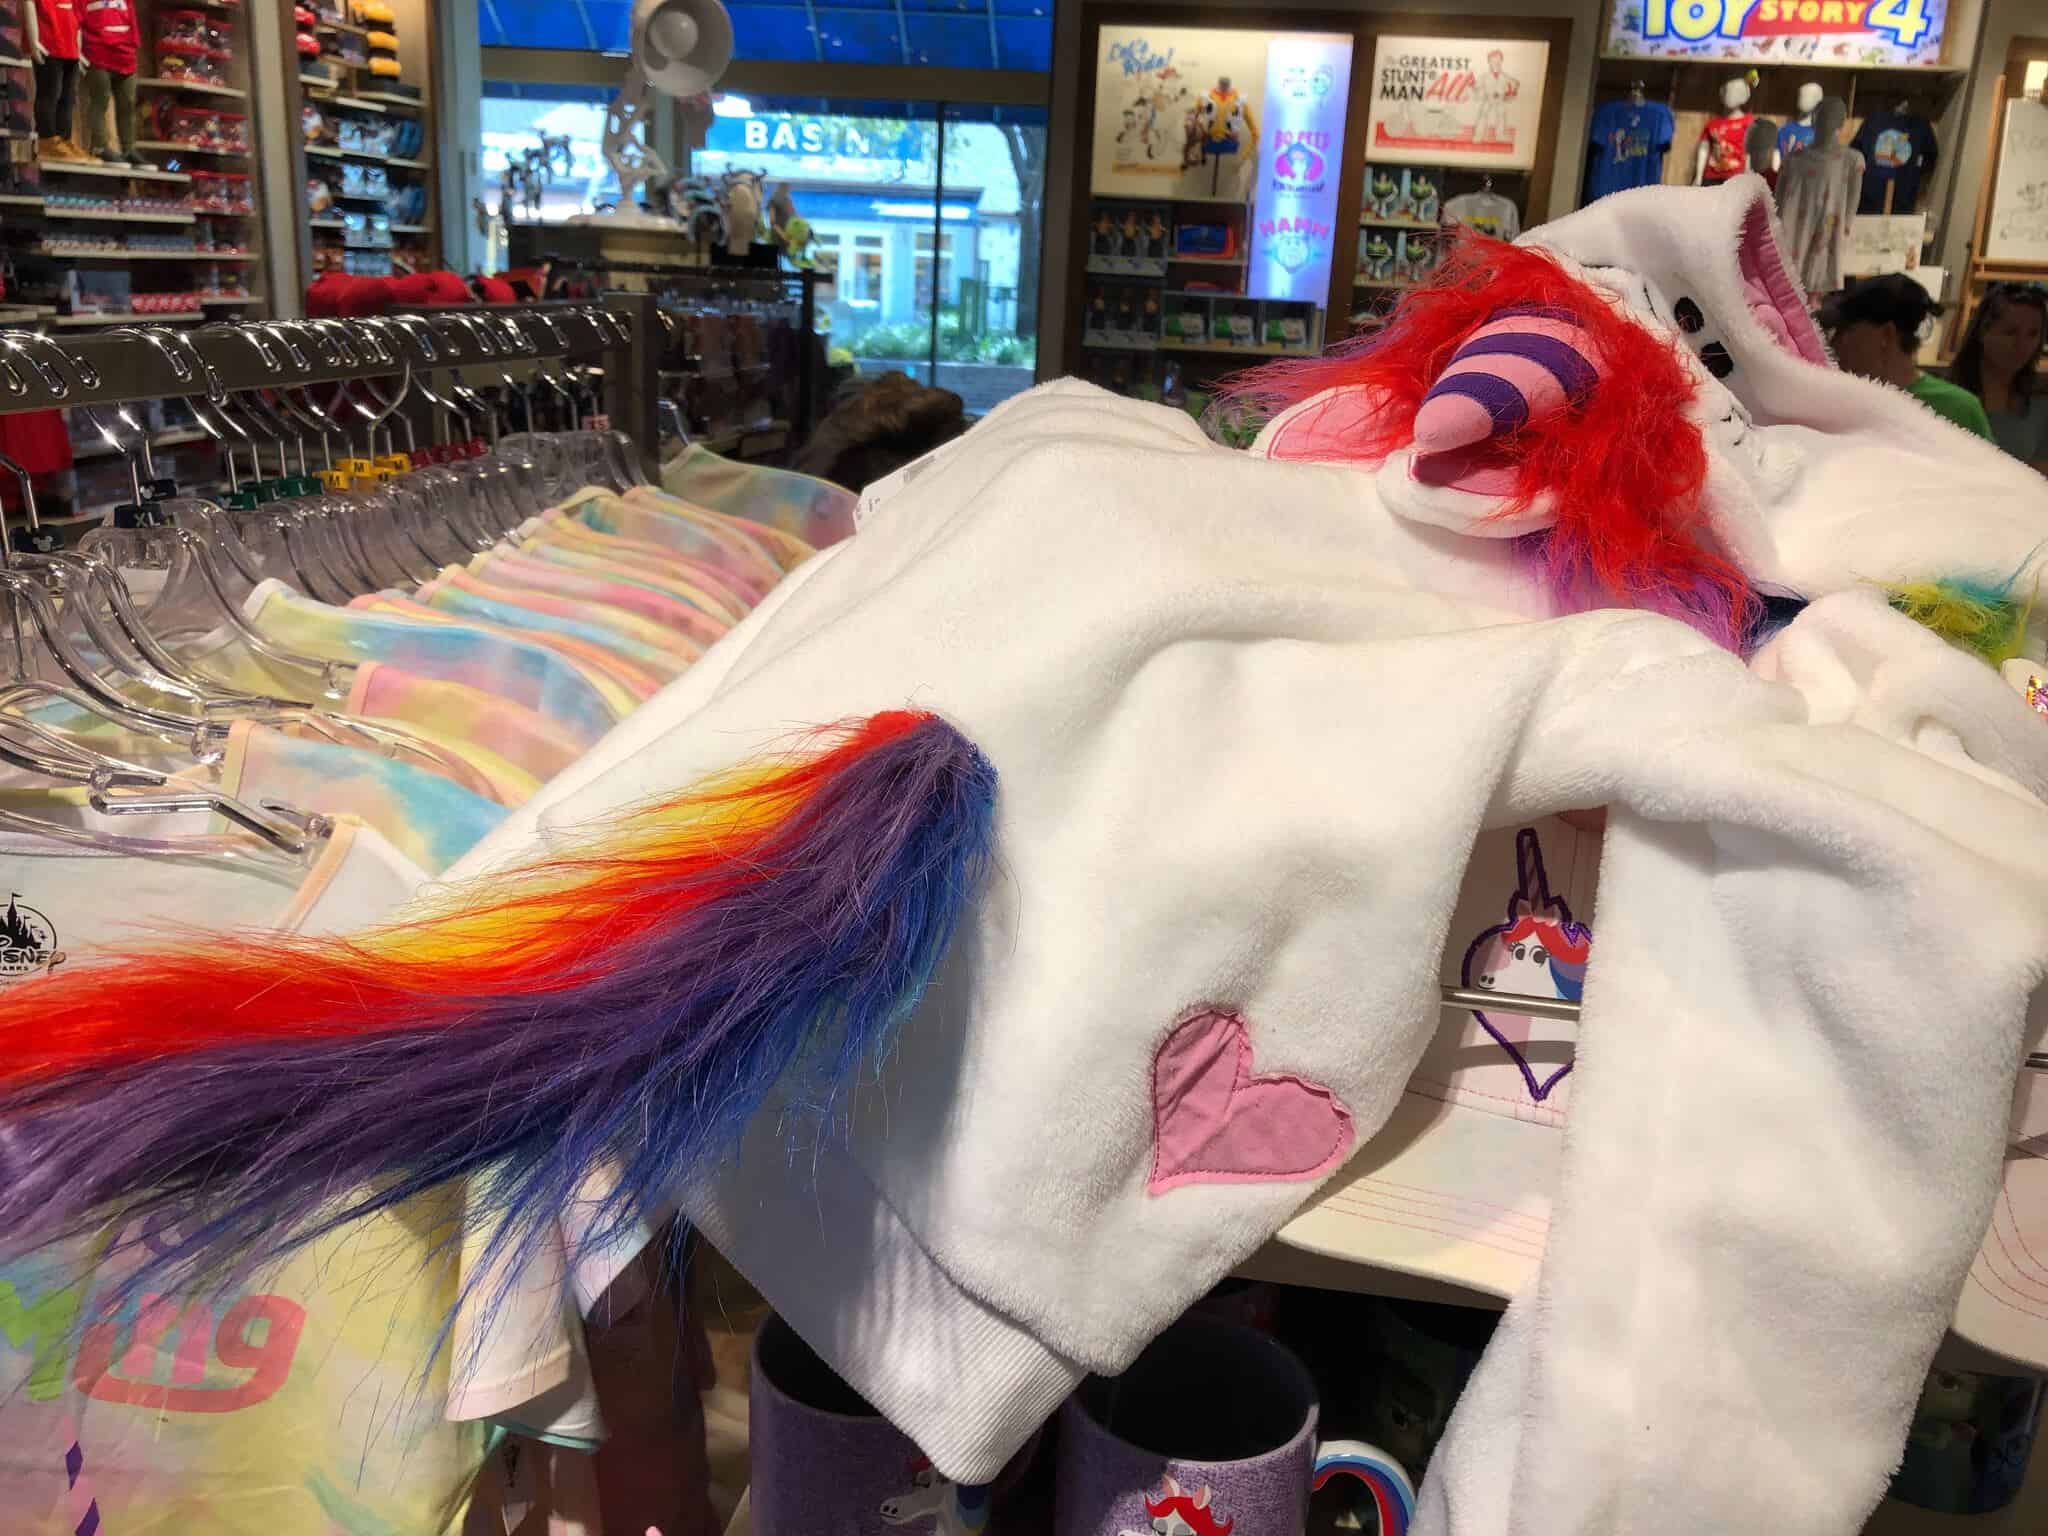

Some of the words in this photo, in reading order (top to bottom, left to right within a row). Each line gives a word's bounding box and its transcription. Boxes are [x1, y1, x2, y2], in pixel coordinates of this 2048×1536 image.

[1758, 0, 1870, 24] STORY
[1864, 0, 1932, 48] 4
[1399, 55, 1472, 70] GREATEST
[1381, 68, 1426, 83] STUNT
[1380, 84, 1425, 102] MAN
[352, 460, 366, 473] M
